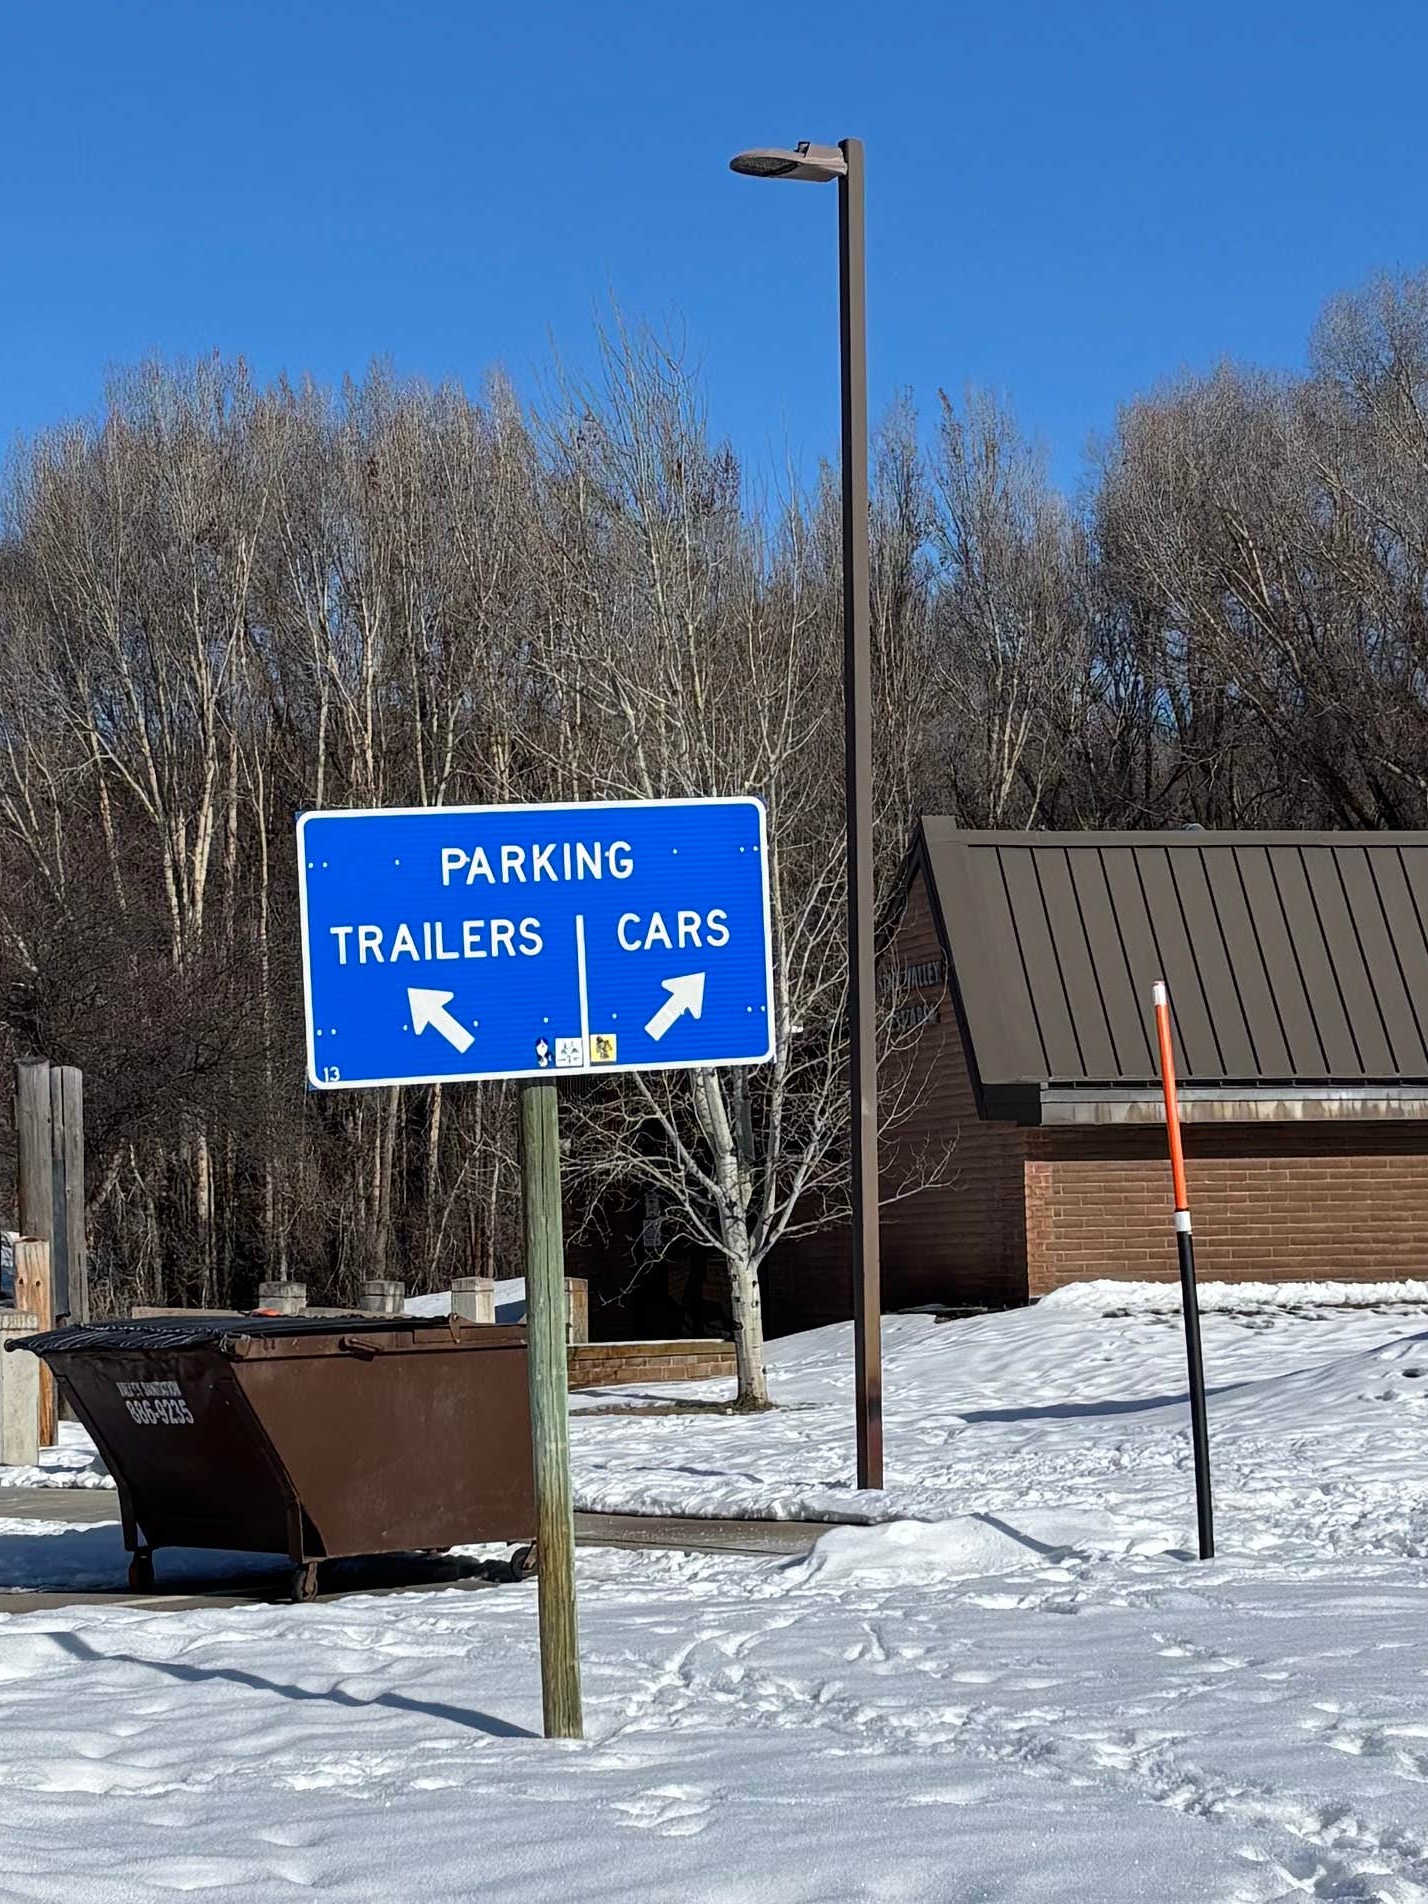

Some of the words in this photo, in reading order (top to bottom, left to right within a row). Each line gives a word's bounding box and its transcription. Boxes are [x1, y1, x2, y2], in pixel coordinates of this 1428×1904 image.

[441, 841, 635, 886] PARKING
[330, 917, 544, 965] TRAILERS
[617, 909, 731, 952] CARS
[323, 1066, 341, 1083] 13
[125, 1399, 195, 1425] 886-9235
